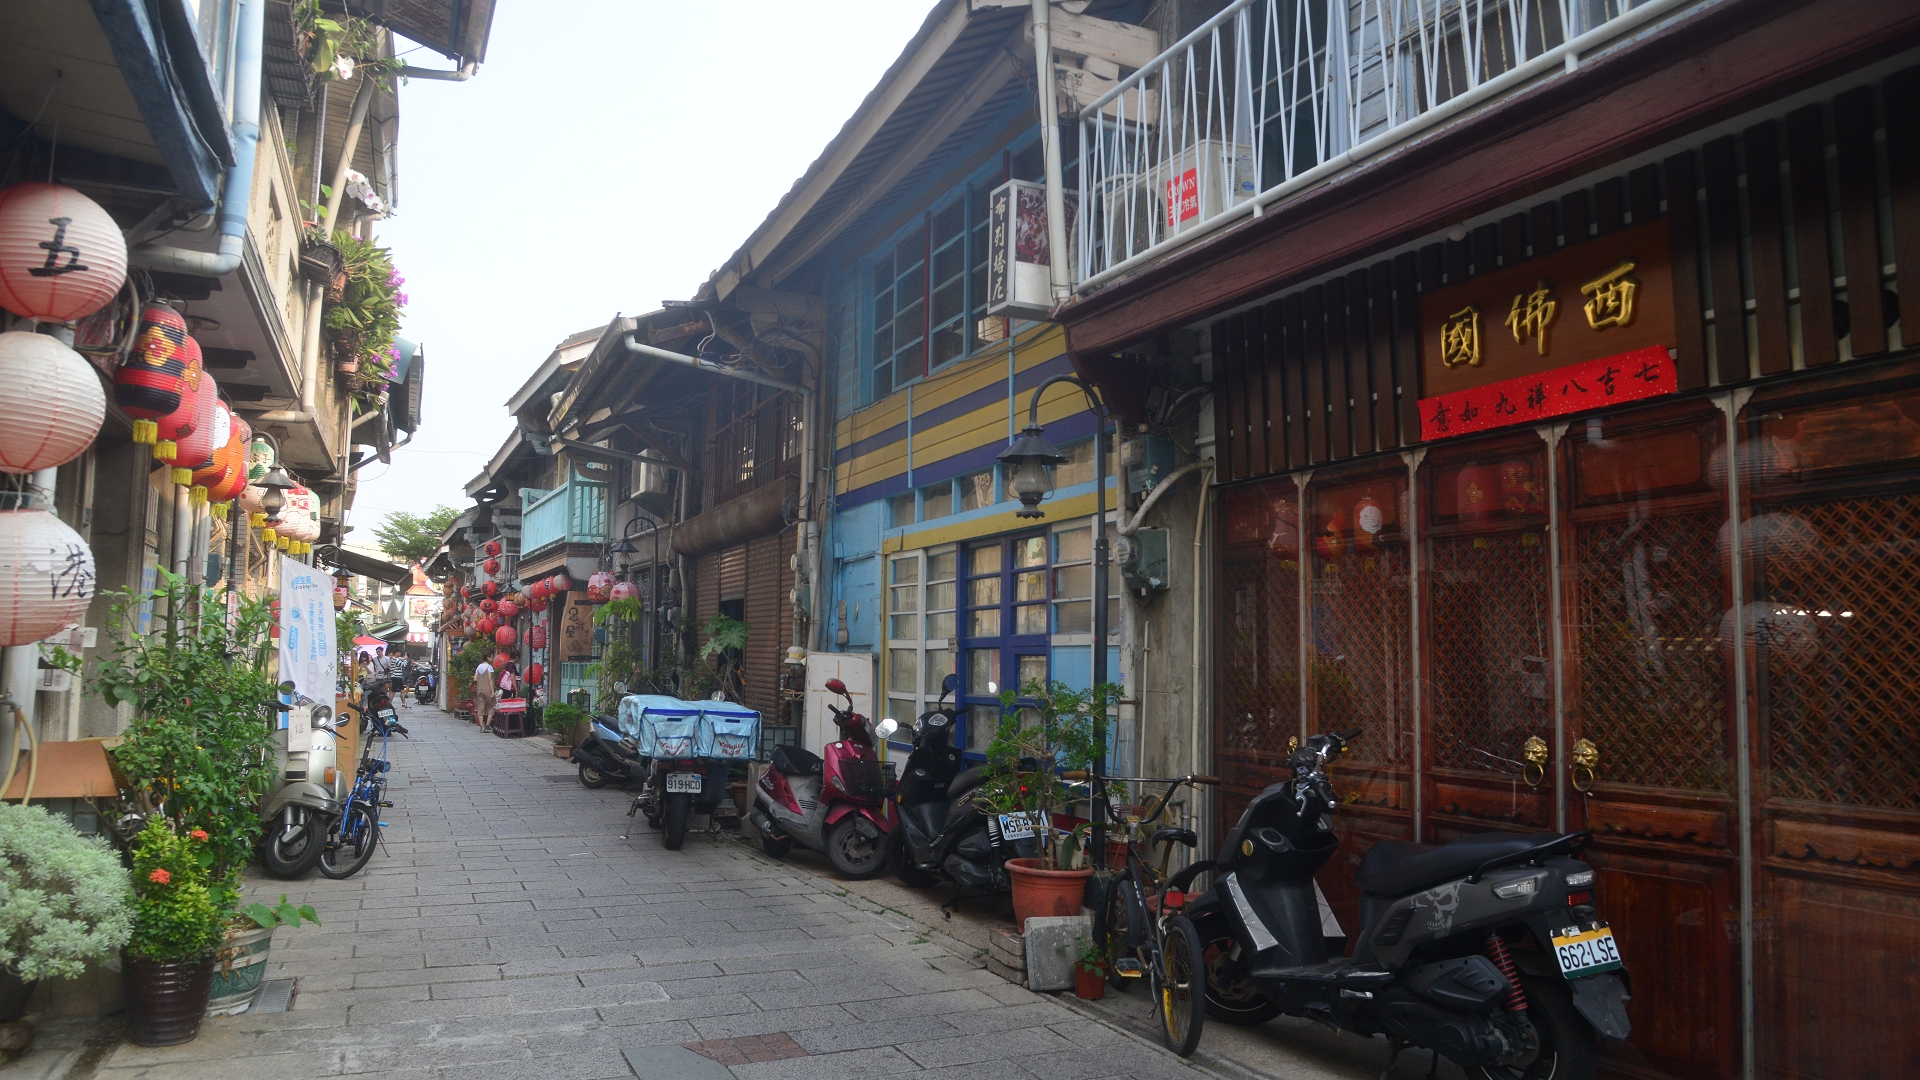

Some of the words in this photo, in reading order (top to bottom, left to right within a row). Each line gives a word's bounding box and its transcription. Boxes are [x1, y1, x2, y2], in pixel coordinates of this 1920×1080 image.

[28, 217, 88, 277] 五
[992, 196, 1006, 301] 布列塔尼
[49, 543, 94, 601] 港
